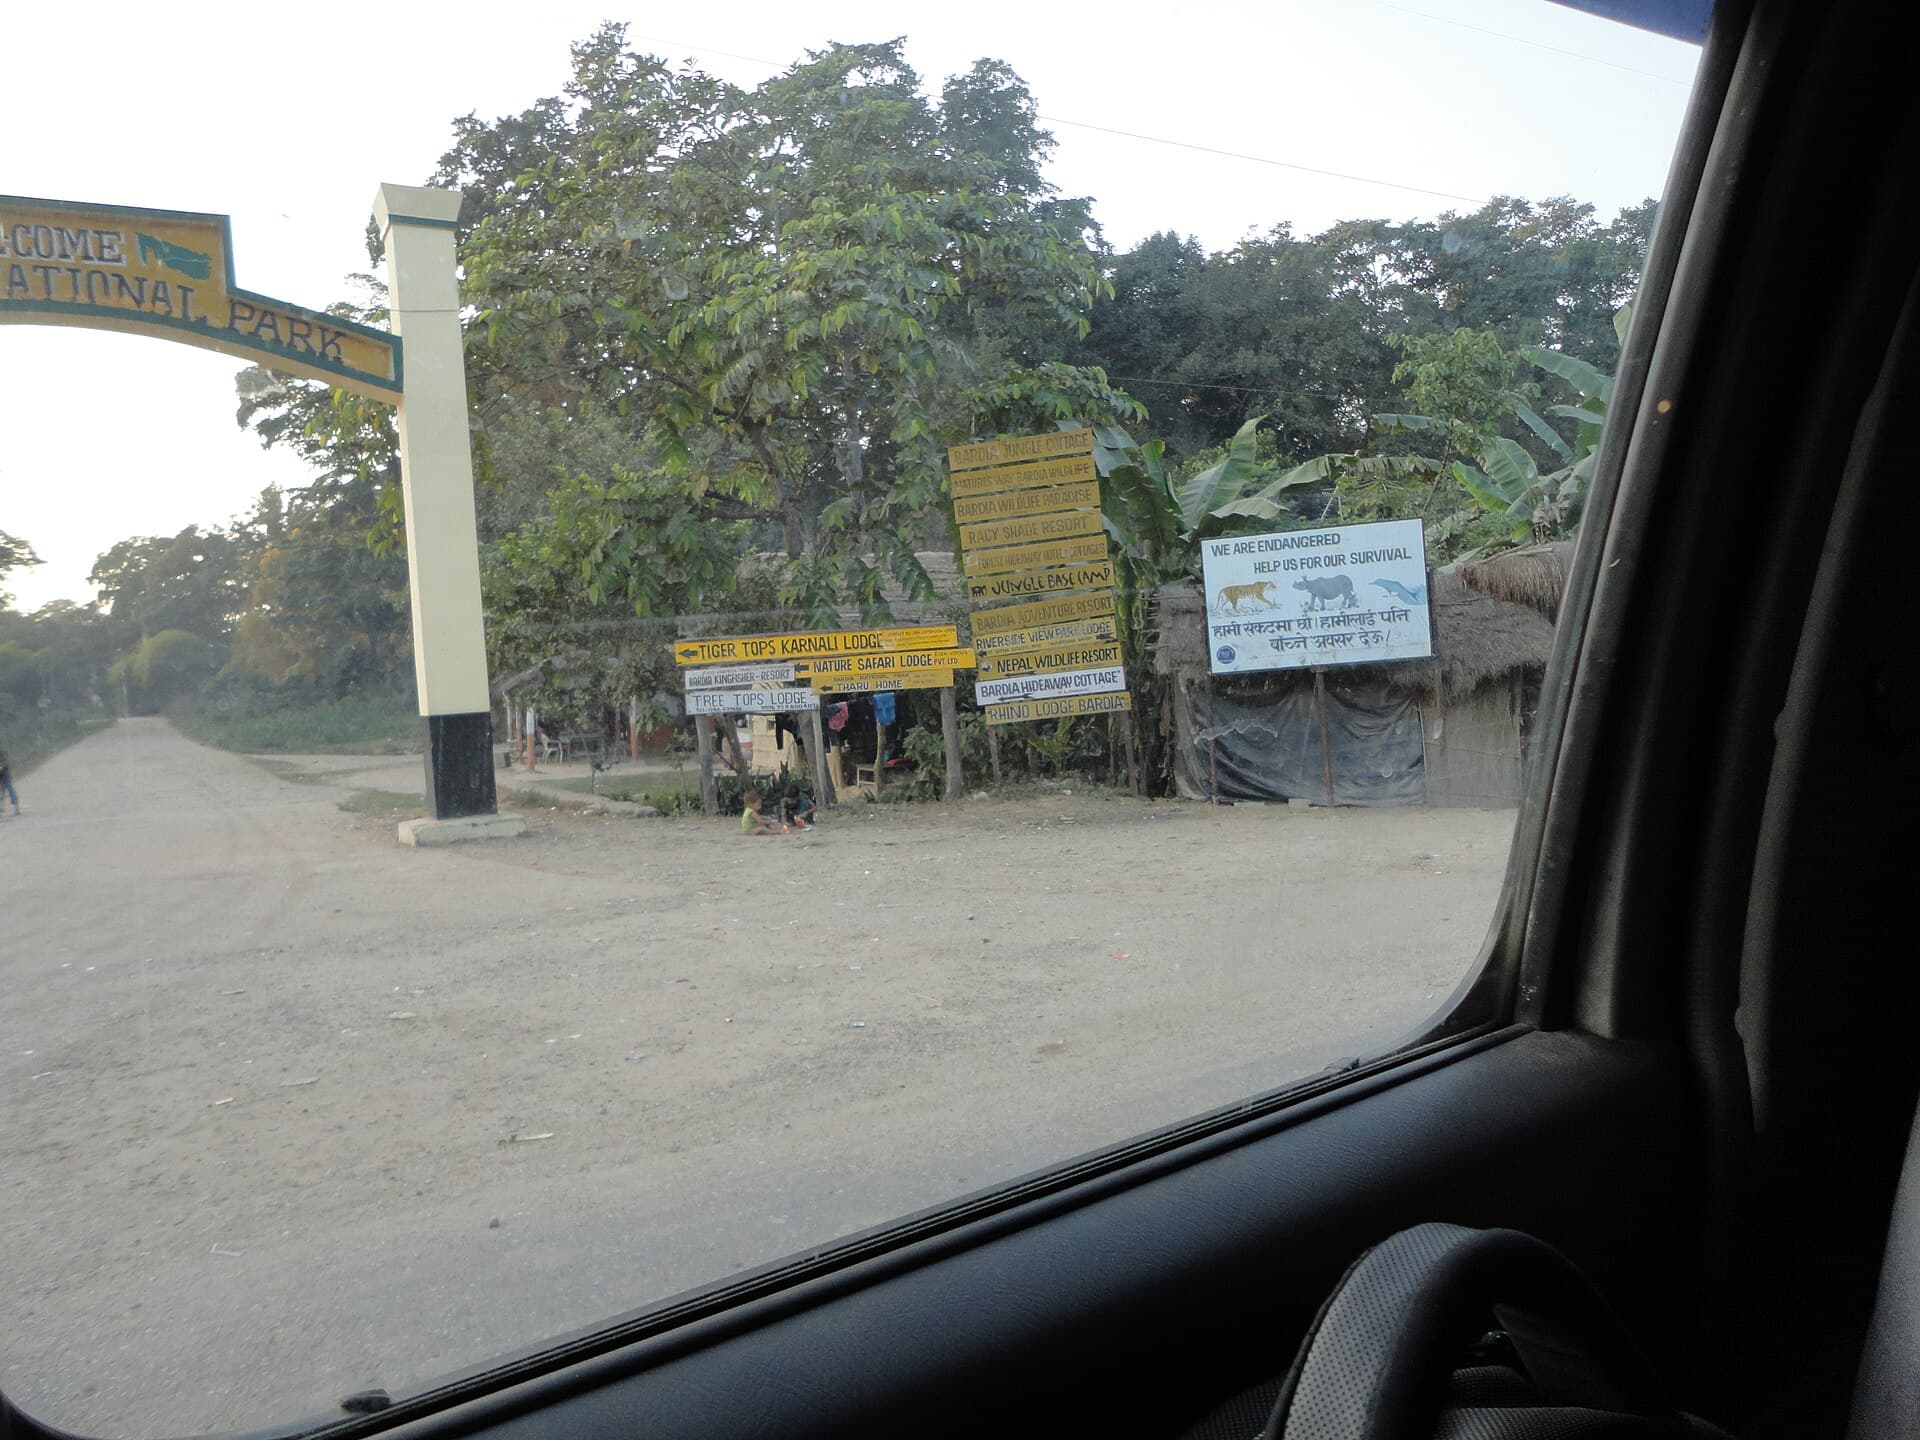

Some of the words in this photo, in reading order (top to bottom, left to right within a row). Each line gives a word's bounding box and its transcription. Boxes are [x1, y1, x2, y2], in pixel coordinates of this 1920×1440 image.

[0, 263, 208, 324] ATIONAL
[226, 298, 347, 364] PARK
[955, 448, 1000, 465] BARDIA
[1003, 441, 1043, 458] JUNGLE
[1045, 432, 1089, 450] COTTAGE
[957, 500, 997, 517] BARDIA
[998, 495, 1041, 514] WILDLIFE
[1043, 488, 1092, 507] PARADISE
[968, 527, 999, 545] RACY
[1003, 522, 1038, 541] SHADE
[1042, 515, 1089, 534] RESORT
[1211, 543, 1231, 557] WE
[1232, 540, 1256, 554] ARE
[1257, 533, 1341, 553] ENDANGERED
[1254, 560, 1281, 575] HELP
[1283, 558, 1298, 571] US
[1300, 556, 1323, 570] FOR
[1323, 554, 1347, 567] OUR
[1350, 547, 1413, 565] SURVIVAL
[991, 576, 1045, 596] JUNGLE
[1047, 572, 1077, 588] BASE
[1077, 567, 1111, 585] CAMP
[977, 615, 1016, 631] BARDIA
[1017, 604, 1075, 626] ADVENTURE
[1076, 597, 1113, 615] RESORT
[1211, 621, 1241, 639] हामी
[1379, 605, 1411, 623] पनि
[698, 643, 736, 660] TIGER
[741, 639, 776, 657] TOPS
[781, 634, 839, 654] KARNALI
[843, 632, 884, 651] LODGE
[976, 632, 1025, 651] RIVERSIDE
[1027, 628, 1055, 644] VIEW
[1081, 621, 1112, 636] LODGE
[1310, 631, 1357, 650] अवसर
[813, 658, 853, 673] NATURE
[857, 655, 895, 671] SAFARI
[900, 653, 933, 668] LODGE
[997, 659, 1033, 674] NEPAL
[1034, 651, 1081, 669] WILDLIFE
[1081, 646, 1119, 663] RESORT
[837, 680, 869, 691] THARU
[875, 679, 904, 689] HOME
[980, 681, 1020, 698] BARDIA
[1021, 676, 1073, 694] HIDEAWAY
[1073, 670, 1119, 688] COTTAGE
[693, 695, 725, 707] TREE
[734, 692, 765, 706] TOPS
[771, 691, 807, 705] LODGE
[989, 704, 1030, 721] RHINO
[1036, 701, 1075, 716] LODGE
[1079, 696, 1125, 712] BARDIA
